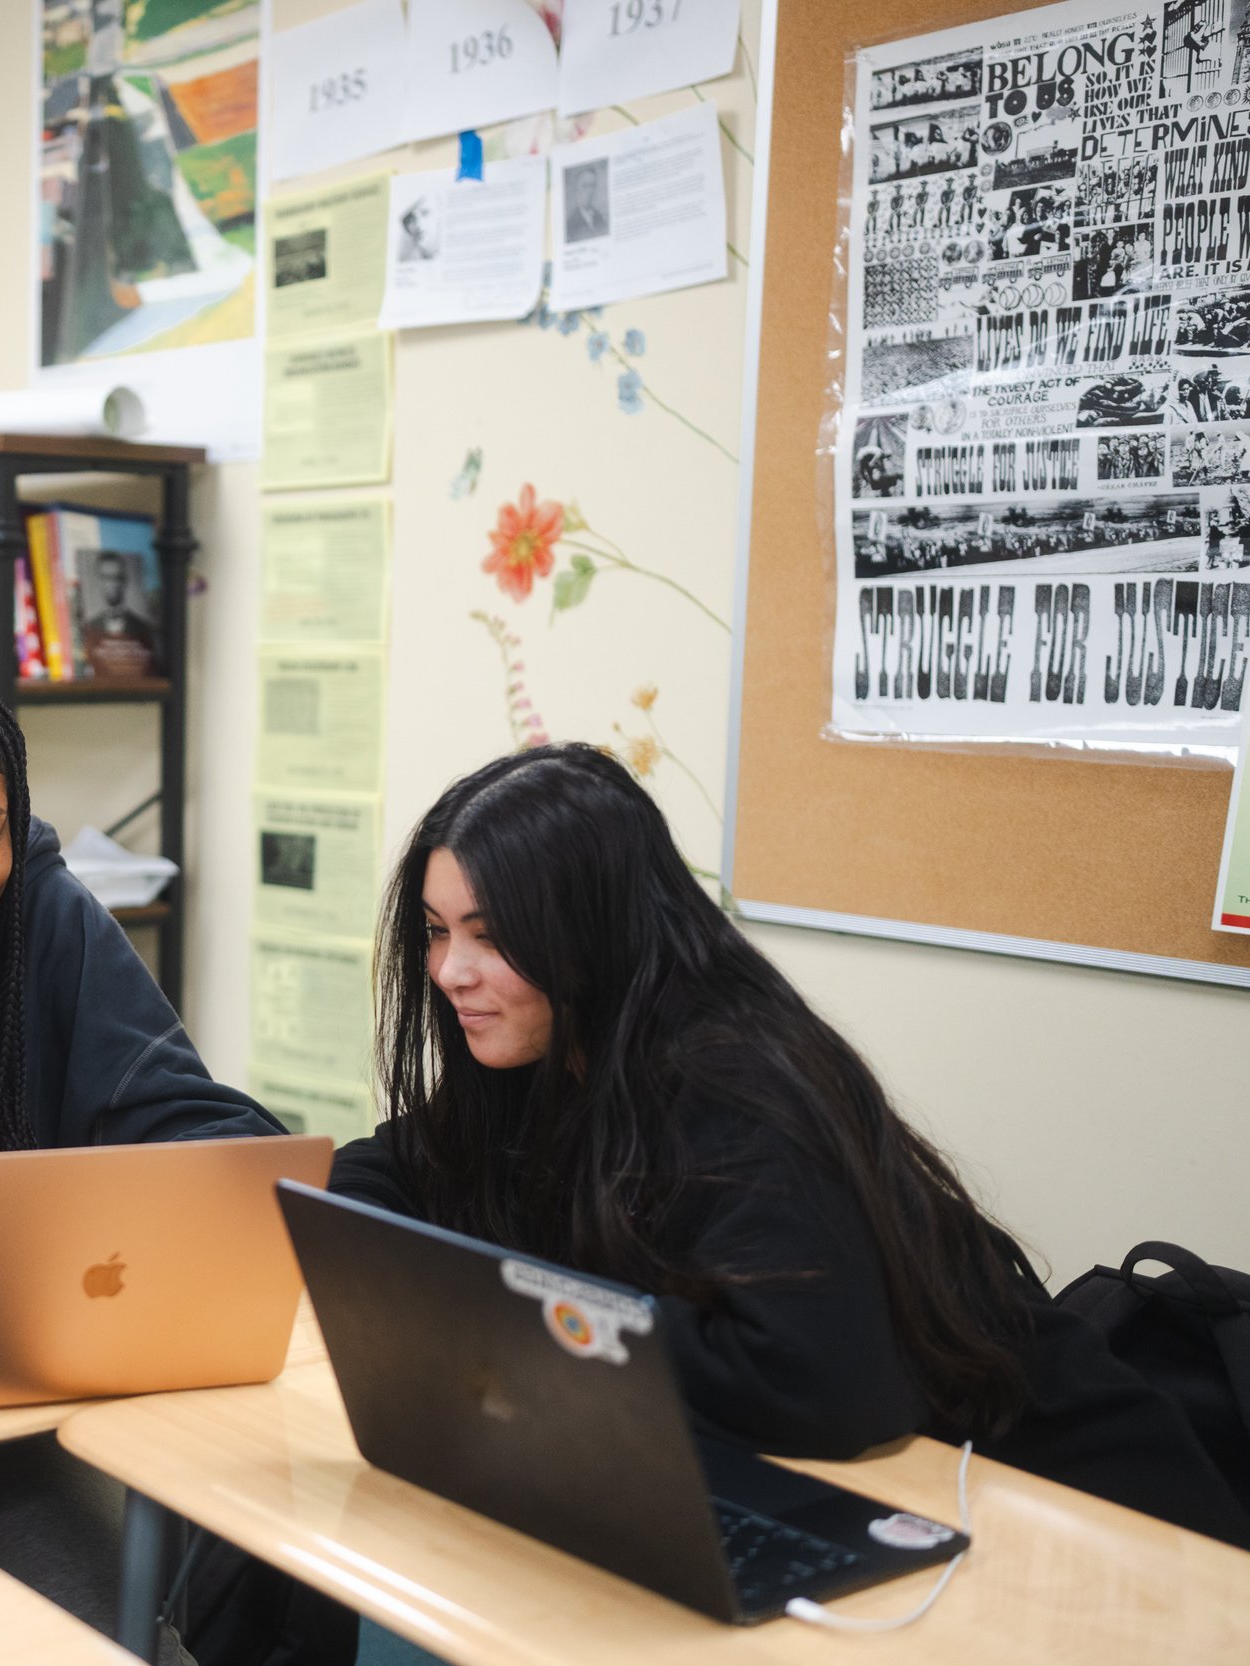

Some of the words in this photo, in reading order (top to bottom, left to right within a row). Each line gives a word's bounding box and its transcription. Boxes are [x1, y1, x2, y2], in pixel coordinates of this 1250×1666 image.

[449, 24, 514, 75] 1936
[986, 32, 1135, 93] BELONG
[1115, 64, 1133, 82] IT
[1139, 59, 1156, 78] IS
[308, 68, 369, 113] 1935
[985, 89, 1027, 119] TO
[1036, 76, 1075, 111] US
[1084, 83, 1121, 104] HOW
[1127, 76, 1153, 94] WE
[1084, 101, 1114, 119] USE
[1117, 93, 1152, 112] OUR
[1082, 113, 1131, 135] LIVES
[1136, 103, 1183, 124] THAT
[1164, 144, 1208, 200] WHAT
[1209, 138, 1250, 194] KIND
[1160, 197, 1231, 266] PEOPLE
[1204, 262, 1220, 276] IT
[1226, 259, 1242, 274] IS
[976, 312, 1024, 373] LIVES
[1054, 306, 1083, 366] WE
[1083, 300, 1128, 362] FIND
[987, 390, 1050, 407] COURAGE
[1038, 378, 1061, 390] ACT
[1064, 376, 1082, 387] OF
[972, 431, 980, 440] A
[1005, 413, 1048, 427] OTHERS
[915, 442, 985, 497] STRUGGLE
[992, 442, 1017, 493] FOR
[1022, 437, 1081, 491] JUSTICE
[855, 584, 1016, 703] STRUGGLE
[1029, 582, 1091, 706] FOR
[1104, 577, 1250, 712] JUSTICE
